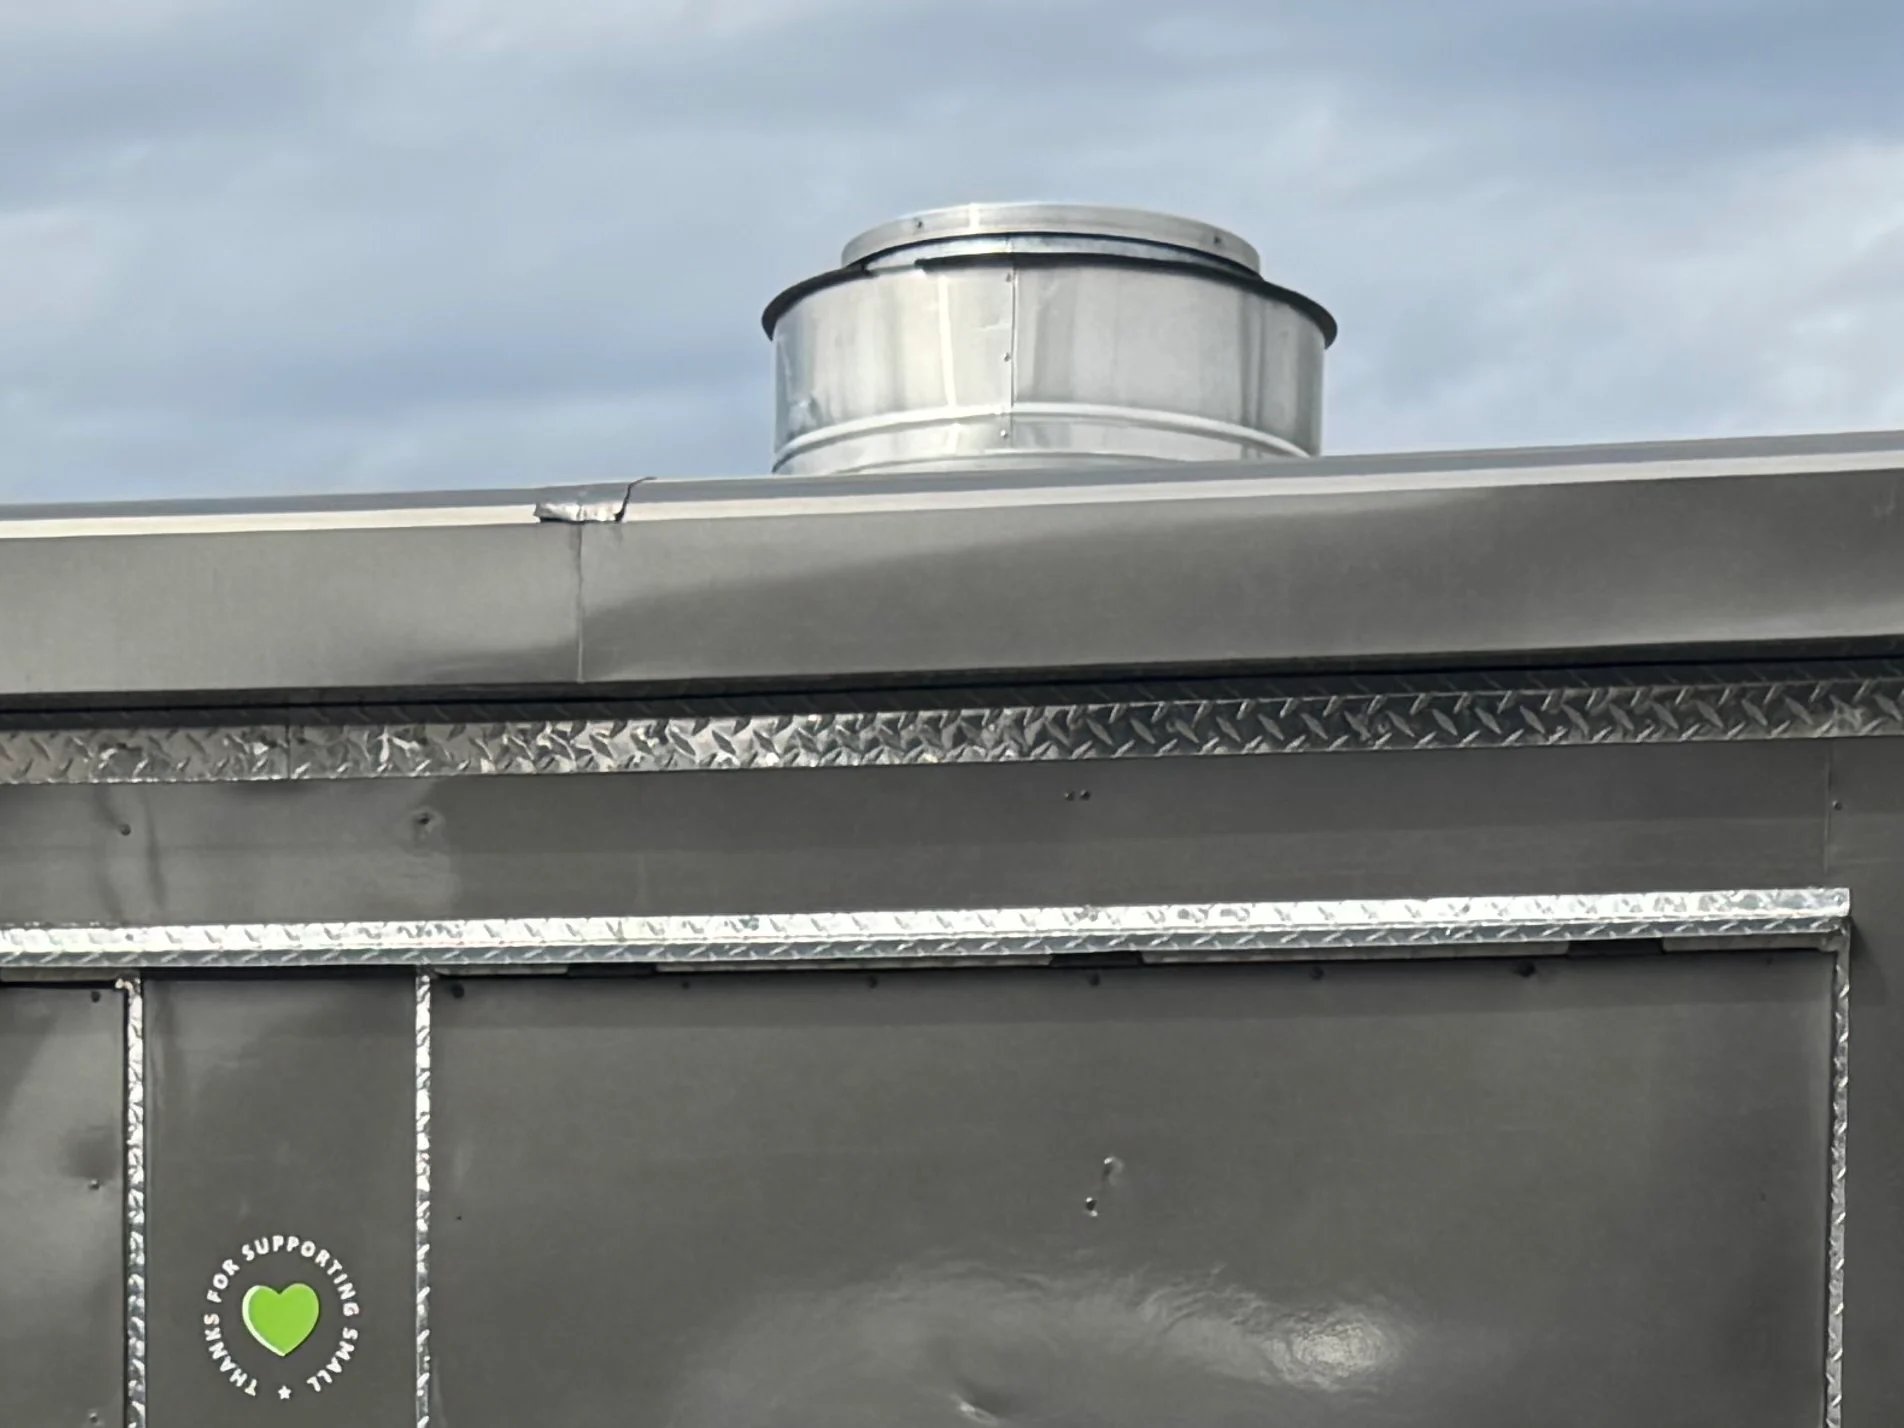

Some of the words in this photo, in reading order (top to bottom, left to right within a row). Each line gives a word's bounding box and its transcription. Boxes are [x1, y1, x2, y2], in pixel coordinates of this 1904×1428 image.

[206, 1258, 240, 1303] FOR
[241, 1234, 360, 1317] SUPPORTING
[203, 1312, 258, 1397] THANKS
[306, 1327, 359, 1393] SMALL
